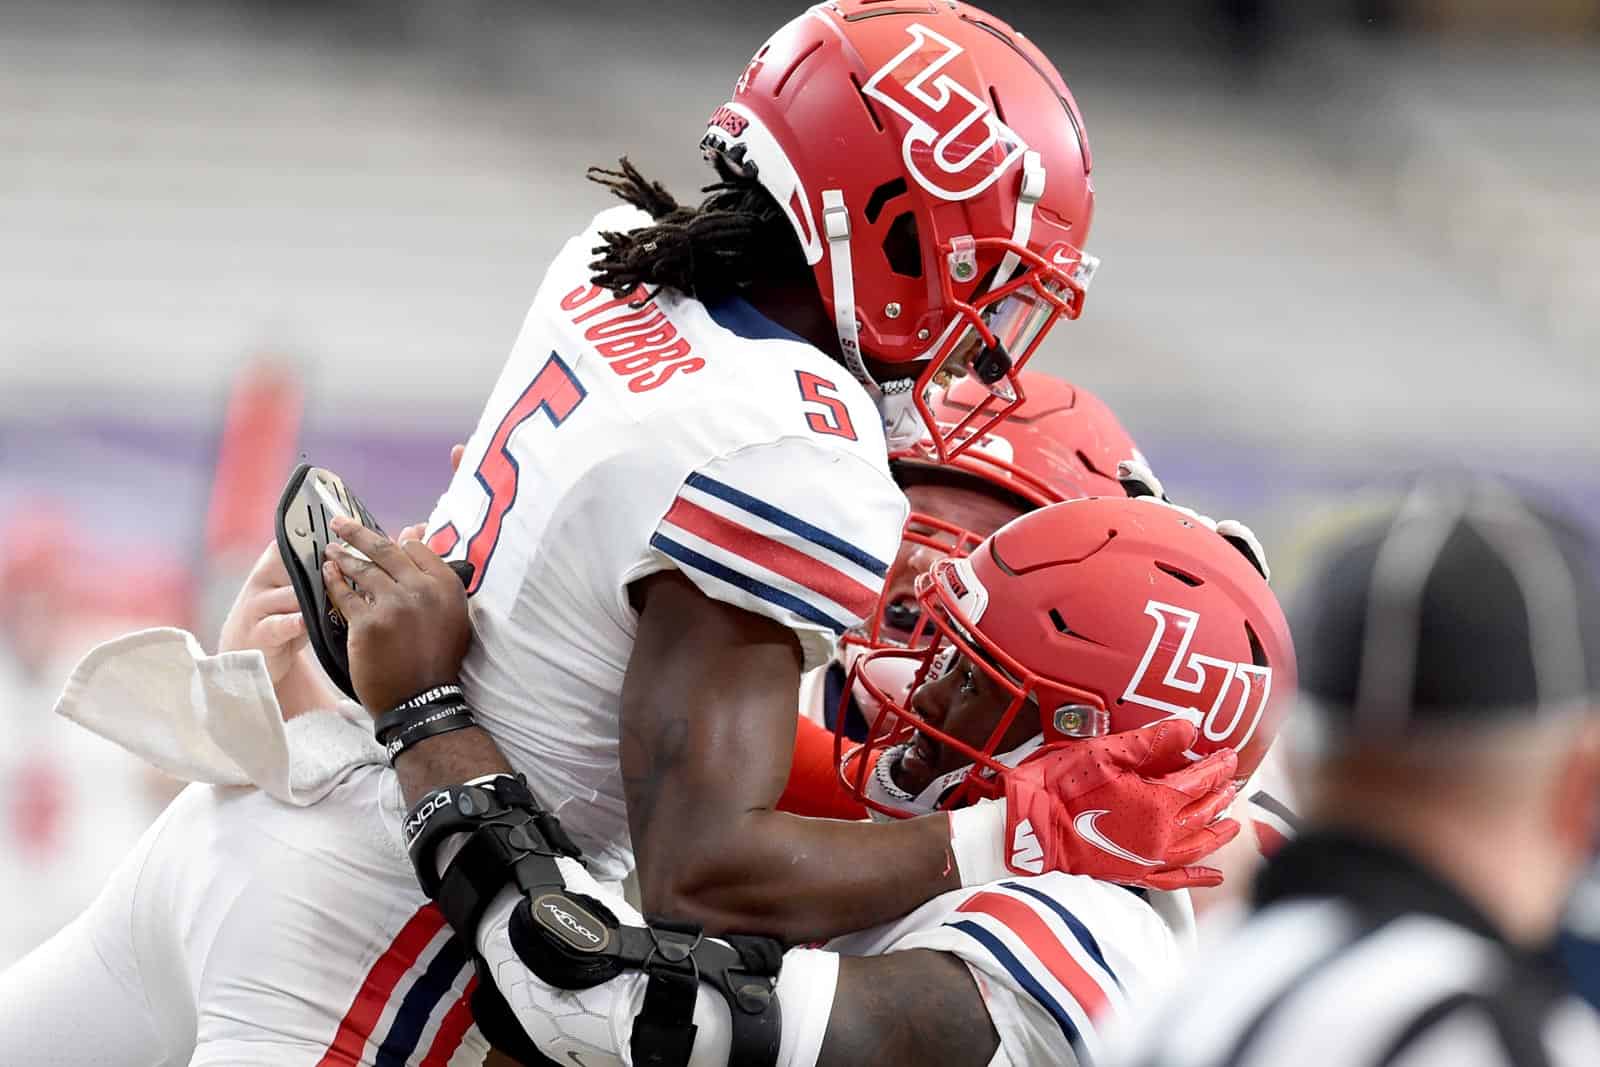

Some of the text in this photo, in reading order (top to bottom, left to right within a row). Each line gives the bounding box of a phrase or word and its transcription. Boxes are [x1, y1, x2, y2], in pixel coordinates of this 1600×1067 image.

[560, 278, 706, 393] STUBBS
[796, 370, 858, 441] 5
[427, 350, 588, 597] 5
[408, 688, 441, 709] LIVES
